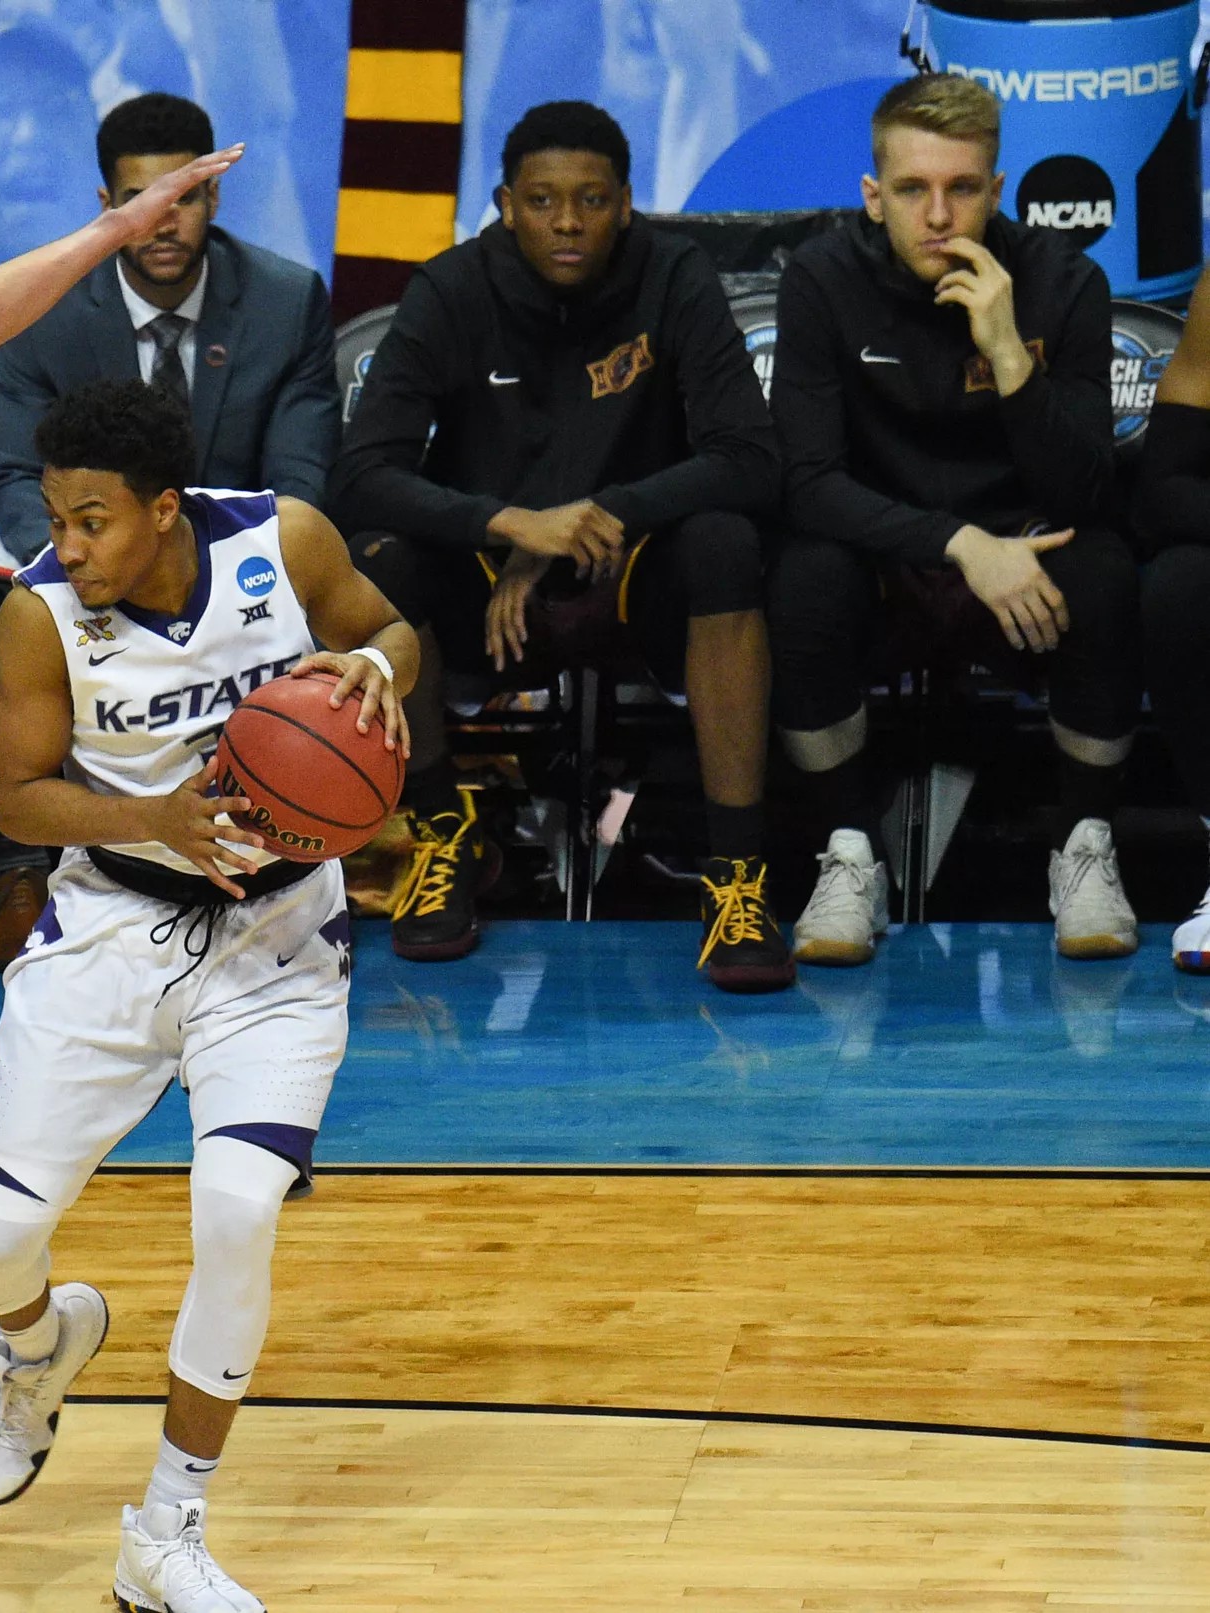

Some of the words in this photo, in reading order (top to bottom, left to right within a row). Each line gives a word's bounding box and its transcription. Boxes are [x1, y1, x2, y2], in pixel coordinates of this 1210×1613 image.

[1026, 200, 1113, 229] NCAA
[243, 570, 276, 589] NCAA
[222, 764, 326, 851] Wlson
